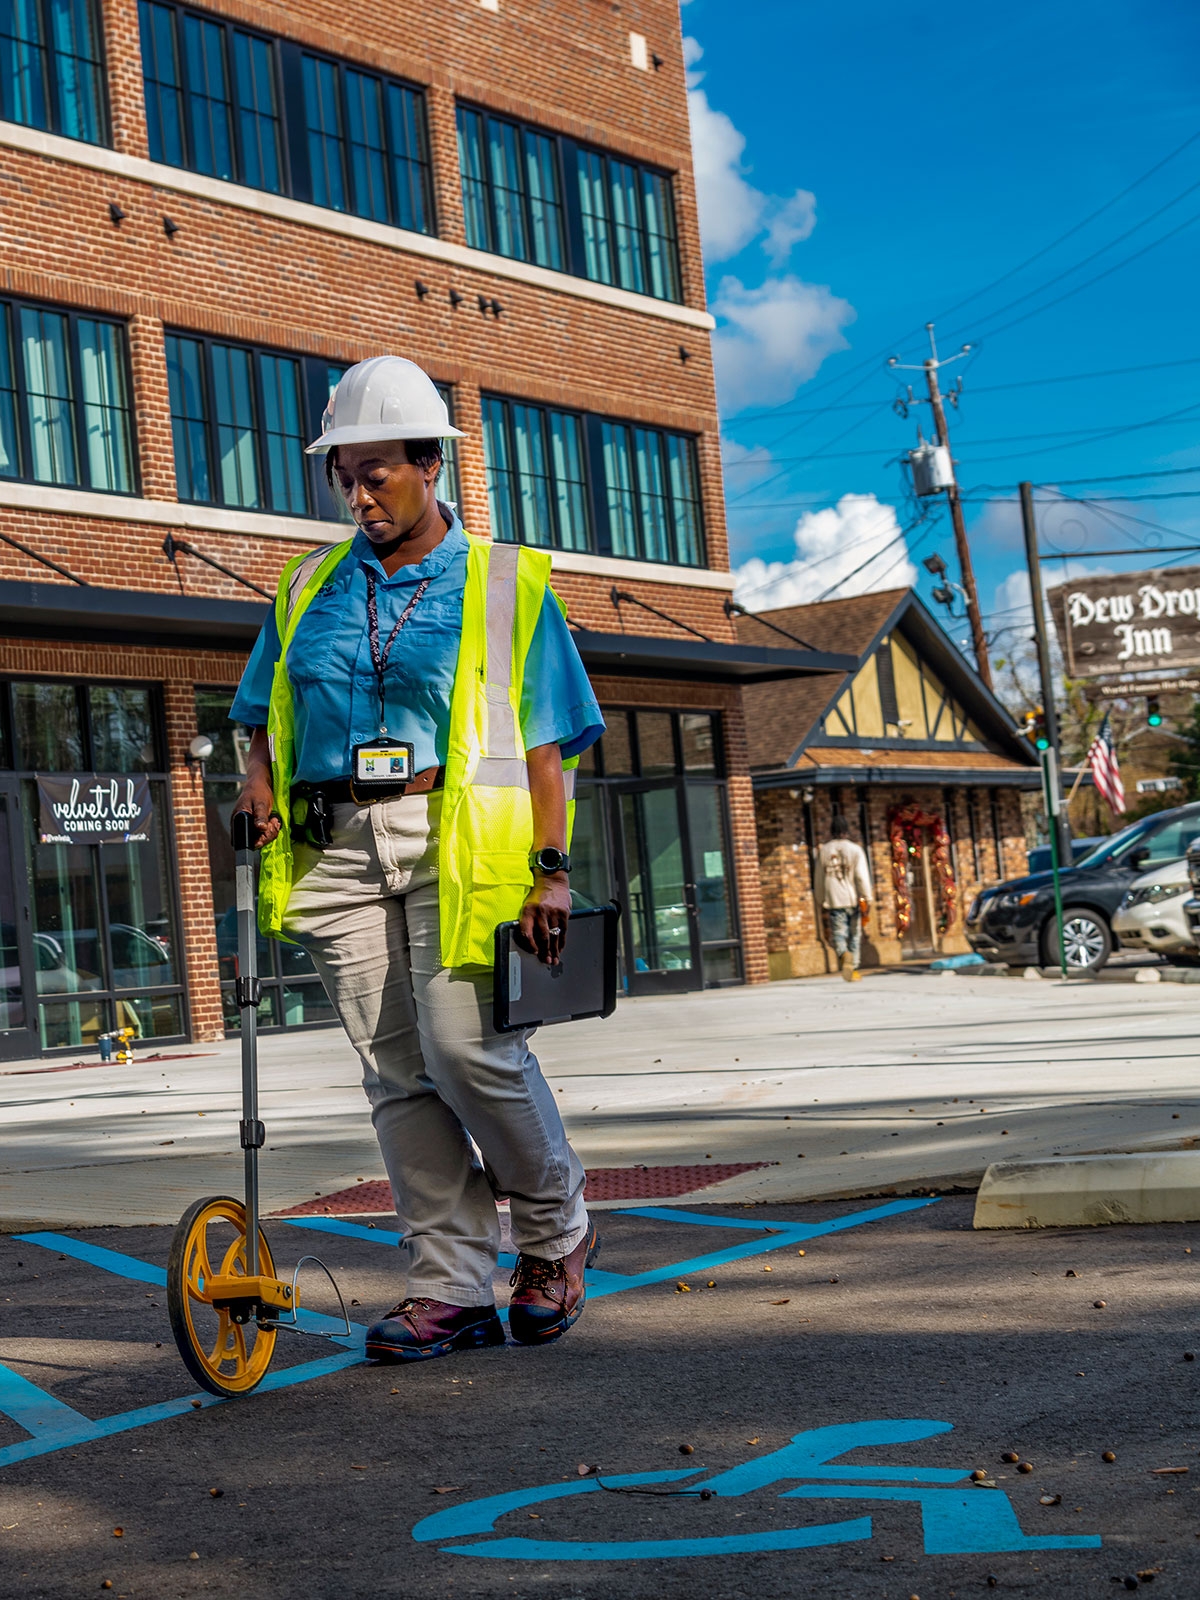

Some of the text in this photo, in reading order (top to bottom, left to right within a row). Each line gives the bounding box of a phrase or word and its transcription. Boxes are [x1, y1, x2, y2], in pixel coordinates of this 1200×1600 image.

[1067, 592, 1134, 627] Dew
[1114, 624, 1173, 660] Inn
[53, 779, 141, 819] velvet lab
[64, 820, 130, 832] COMING SOON
